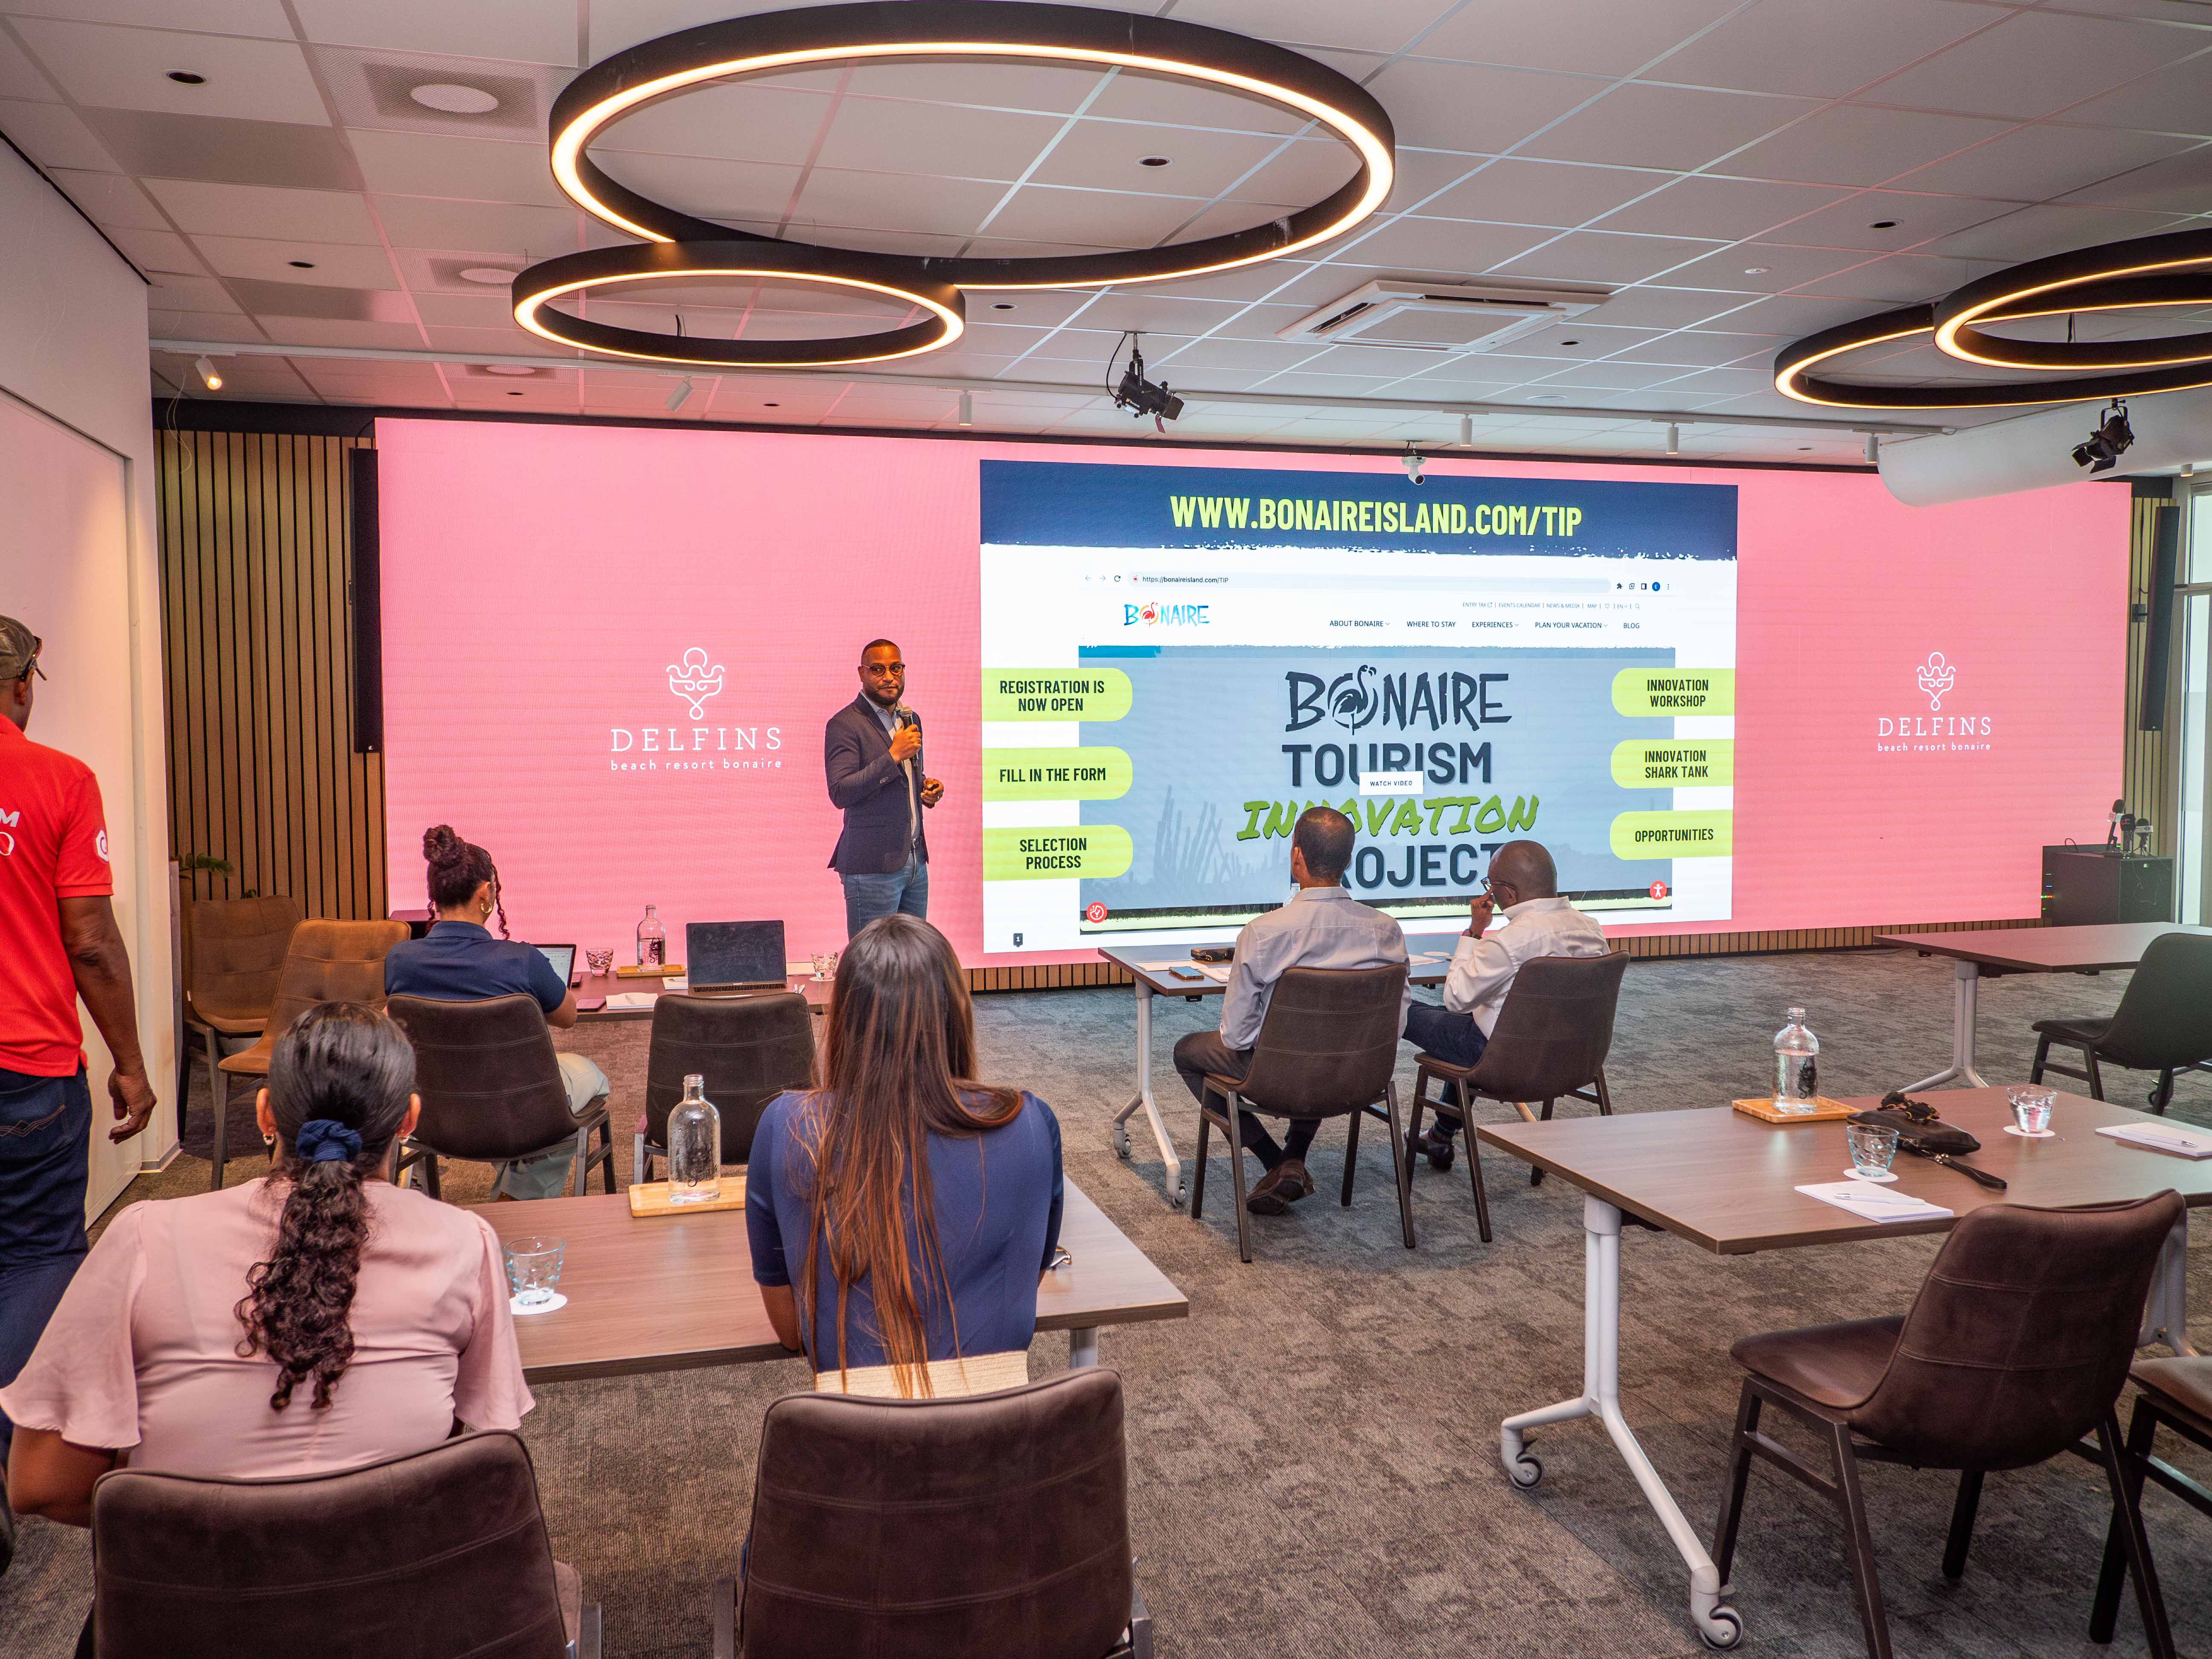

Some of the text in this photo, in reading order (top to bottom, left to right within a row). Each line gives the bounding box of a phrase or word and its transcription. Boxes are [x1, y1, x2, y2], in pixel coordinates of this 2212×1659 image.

[1170, 496, 1582, 536] WWW.BONAIREISLAND.COM/TIP
[1123, 602, 1210, 629] BONAIRE
[1000, 681, 1104, 693] REGISTRATION IS
[1647, 679, 1708, 691] INNOVATION
[1018, 698, 1083, 711] NOW OPEN
[1285, 665, 1512, 735] BONAIRE
[1650, 695, 1706, 707] WORKSHOP
[1878, 717, 1991, 736] DELFINS
[611, 727, 780, 751] DELFINS
[1877, 741, 1991, 751] beach resort bonaire
[1645, 750, 1706, 763] INNOVATION
[610, 757, 782, 771] beach resort bonaire
[1000, 768, 1106, 782] FILL IN THE FORM
[1645, 765, 1708, 779] SHARK TANK
[1237, 795, 1539, 840] INOVATION
[1635, 829, 1714, 842] OPPORTUNITIES
[1020, 838, 1086, 852] SELECTION
[1027, 856, 1081, 869] PROCESS
[1291, 843, 1505, 889] OJEC
